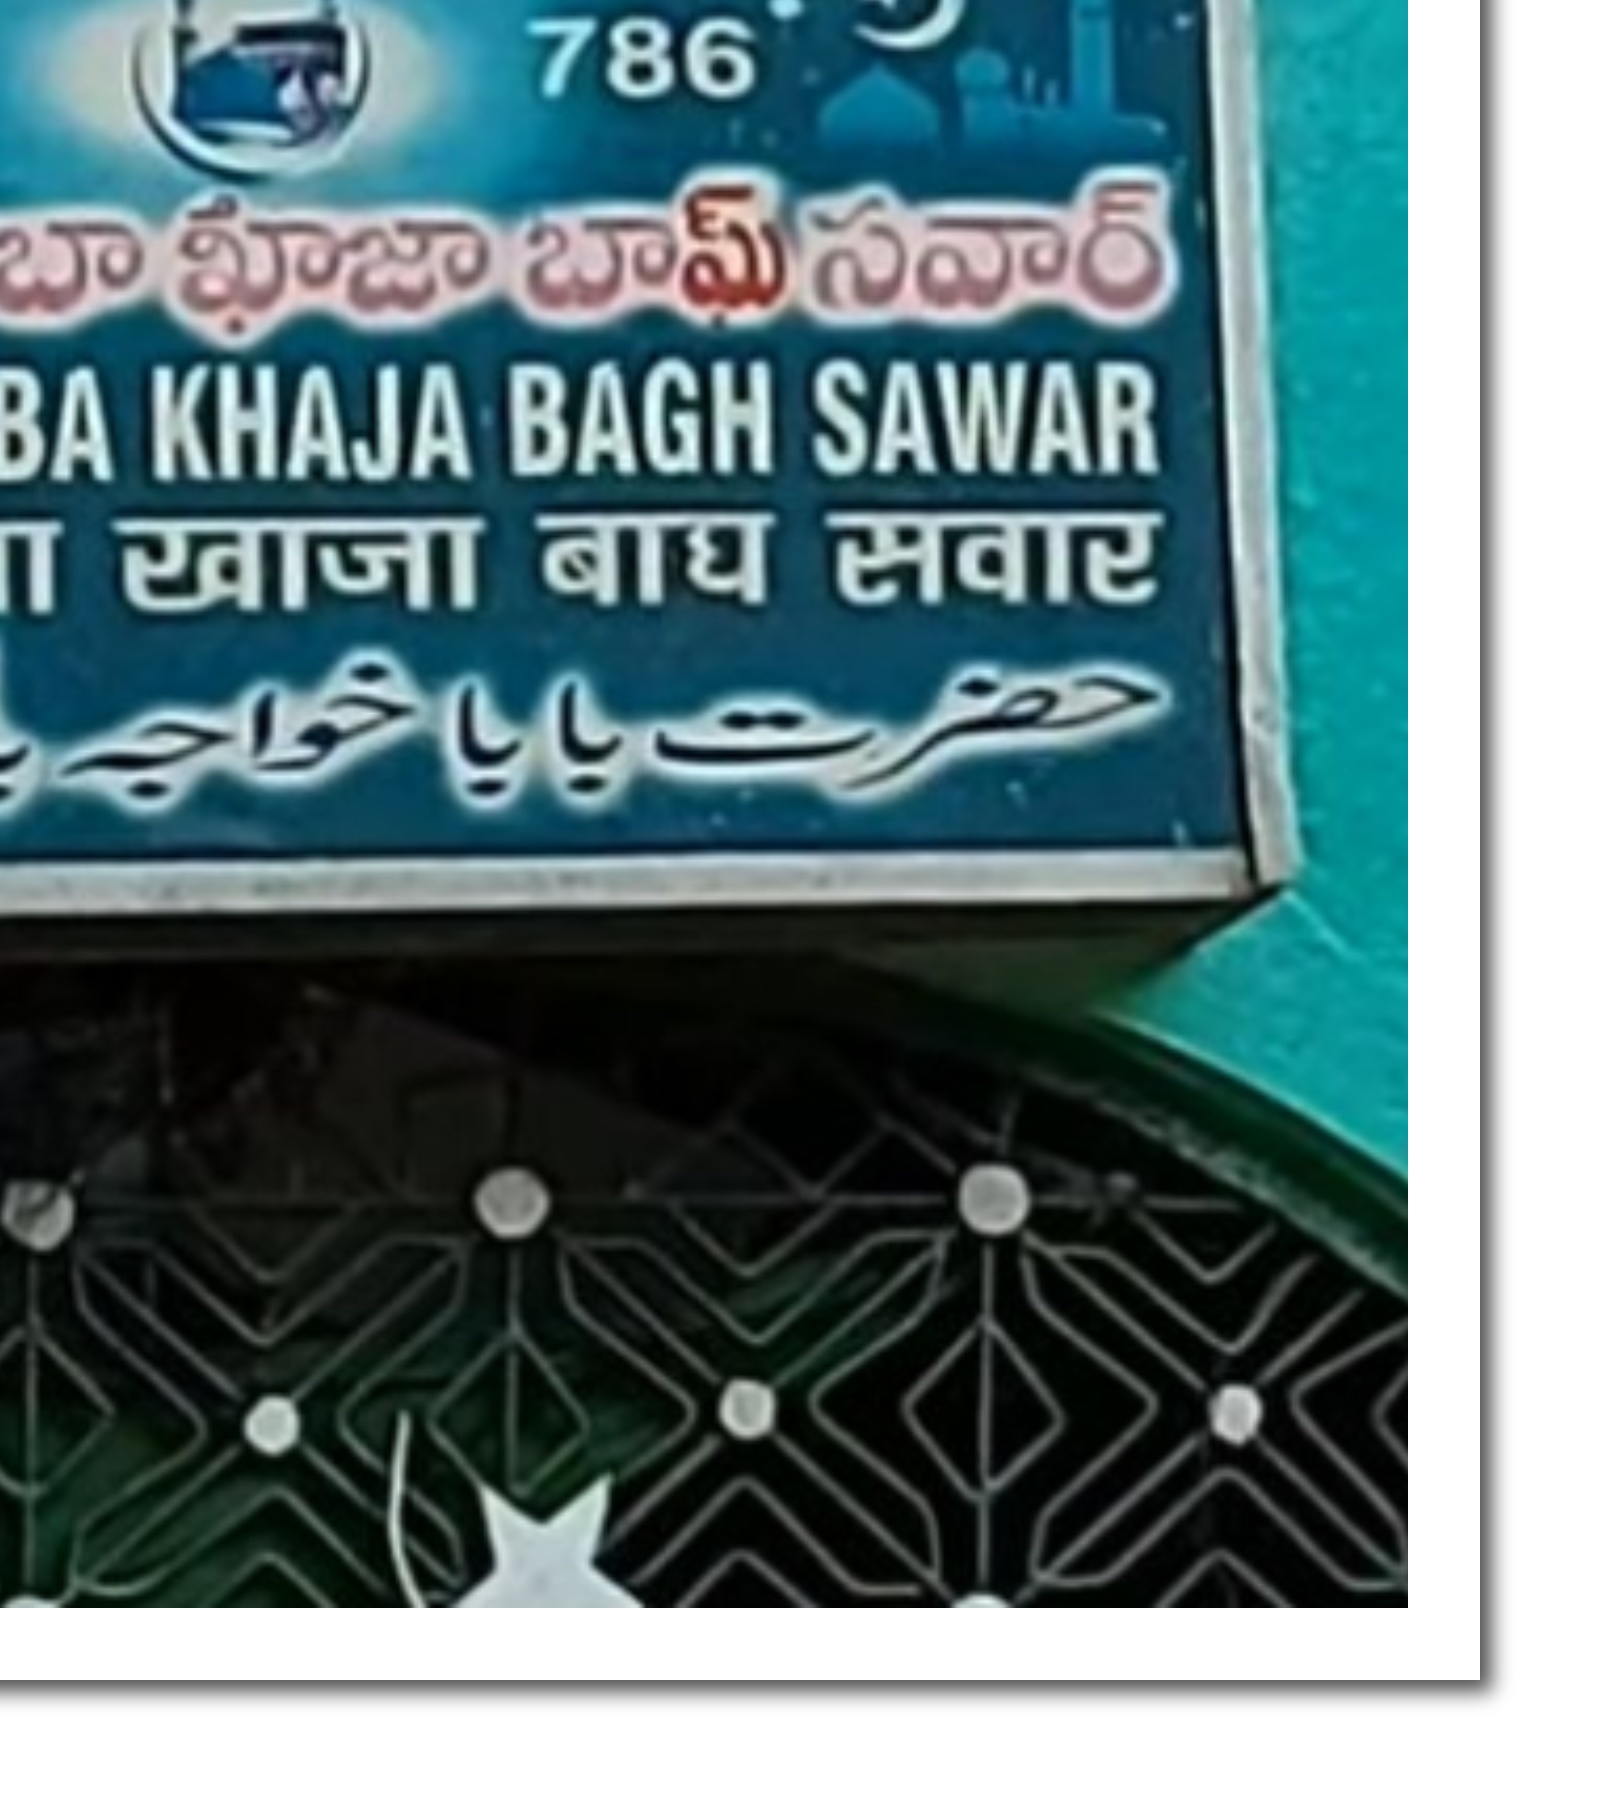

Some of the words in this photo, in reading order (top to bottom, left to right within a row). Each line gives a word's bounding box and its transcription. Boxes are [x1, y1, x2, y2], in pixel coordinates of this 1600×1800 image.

[525, 15, 758, 99] 786
[810, 180, 1163, 310] సవార్
[150, 361, 473, 484] KHAJA
[508, 359, 774, 480] BAGH
[811, 357, 1161, 478] SAWAR
[111, 516, 486, 613] खाजा
[535, 510, 776, 607] बाघ
[825, 509, 1163, 605] सवार
[653, 672, 1161, 792] حضرت
